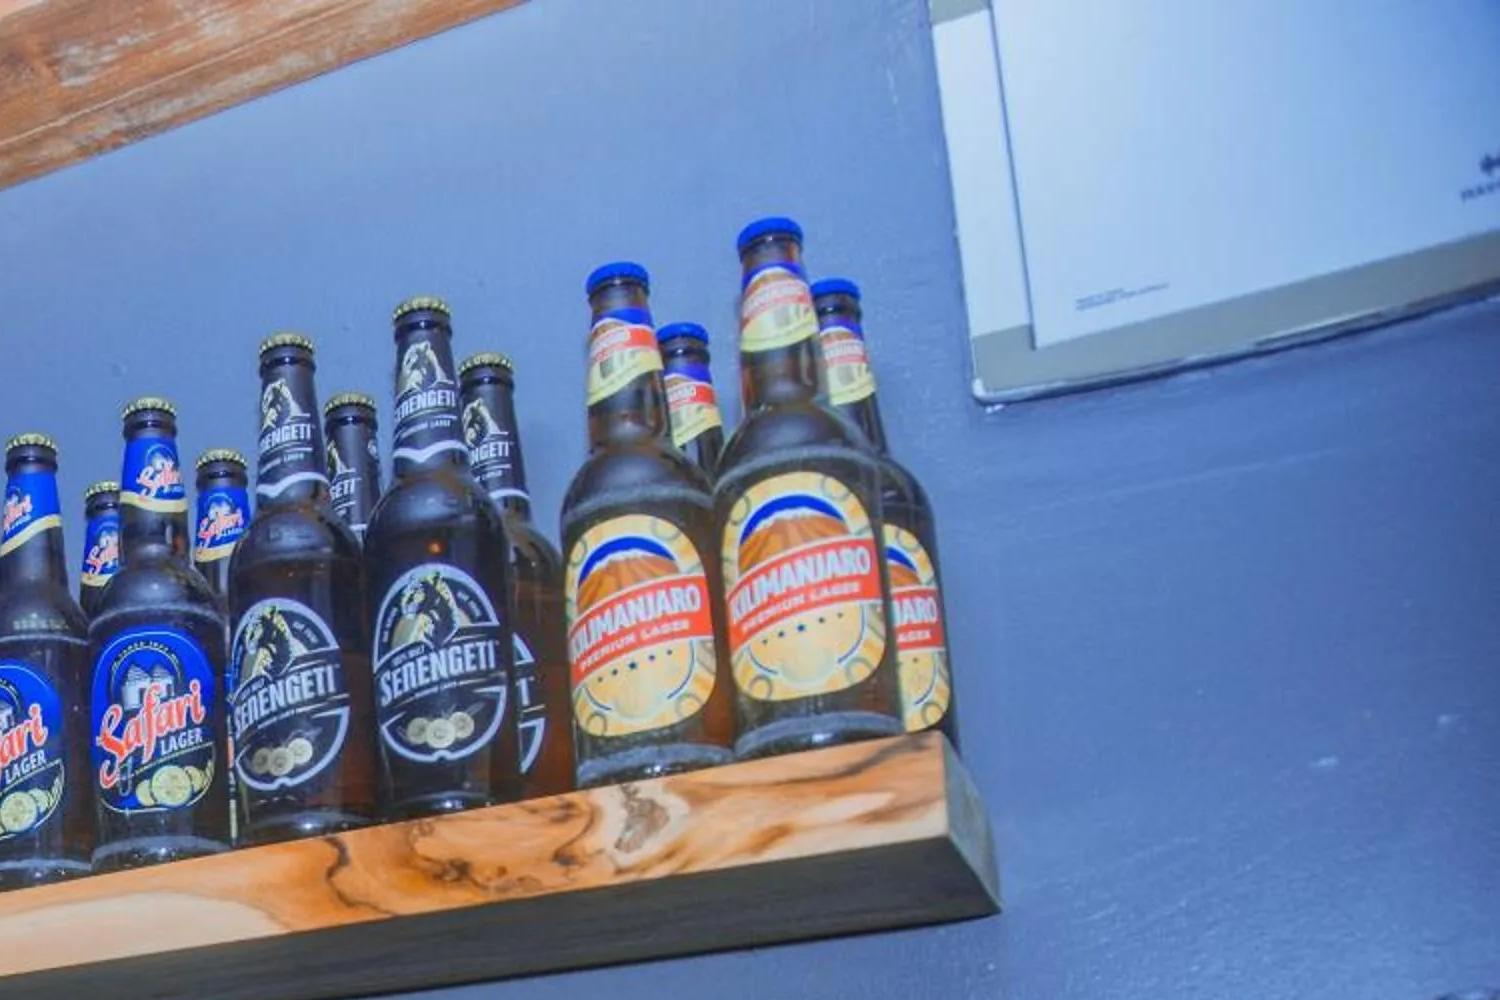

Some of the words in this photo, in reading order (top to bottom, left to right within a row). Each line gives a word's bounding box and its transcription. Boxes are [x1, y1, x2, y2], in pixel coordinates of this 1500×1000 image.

[730, 546, 872, 624] KILIMANJARO
[572, 585, 701, 662] KILIMANJARO
[378, 642, 497, 707] SERENGETI
[4, 750, 47, 785] LAGER
[96, 678, 207, 797] Safari
[160, 727, 204, 756] LAGER
